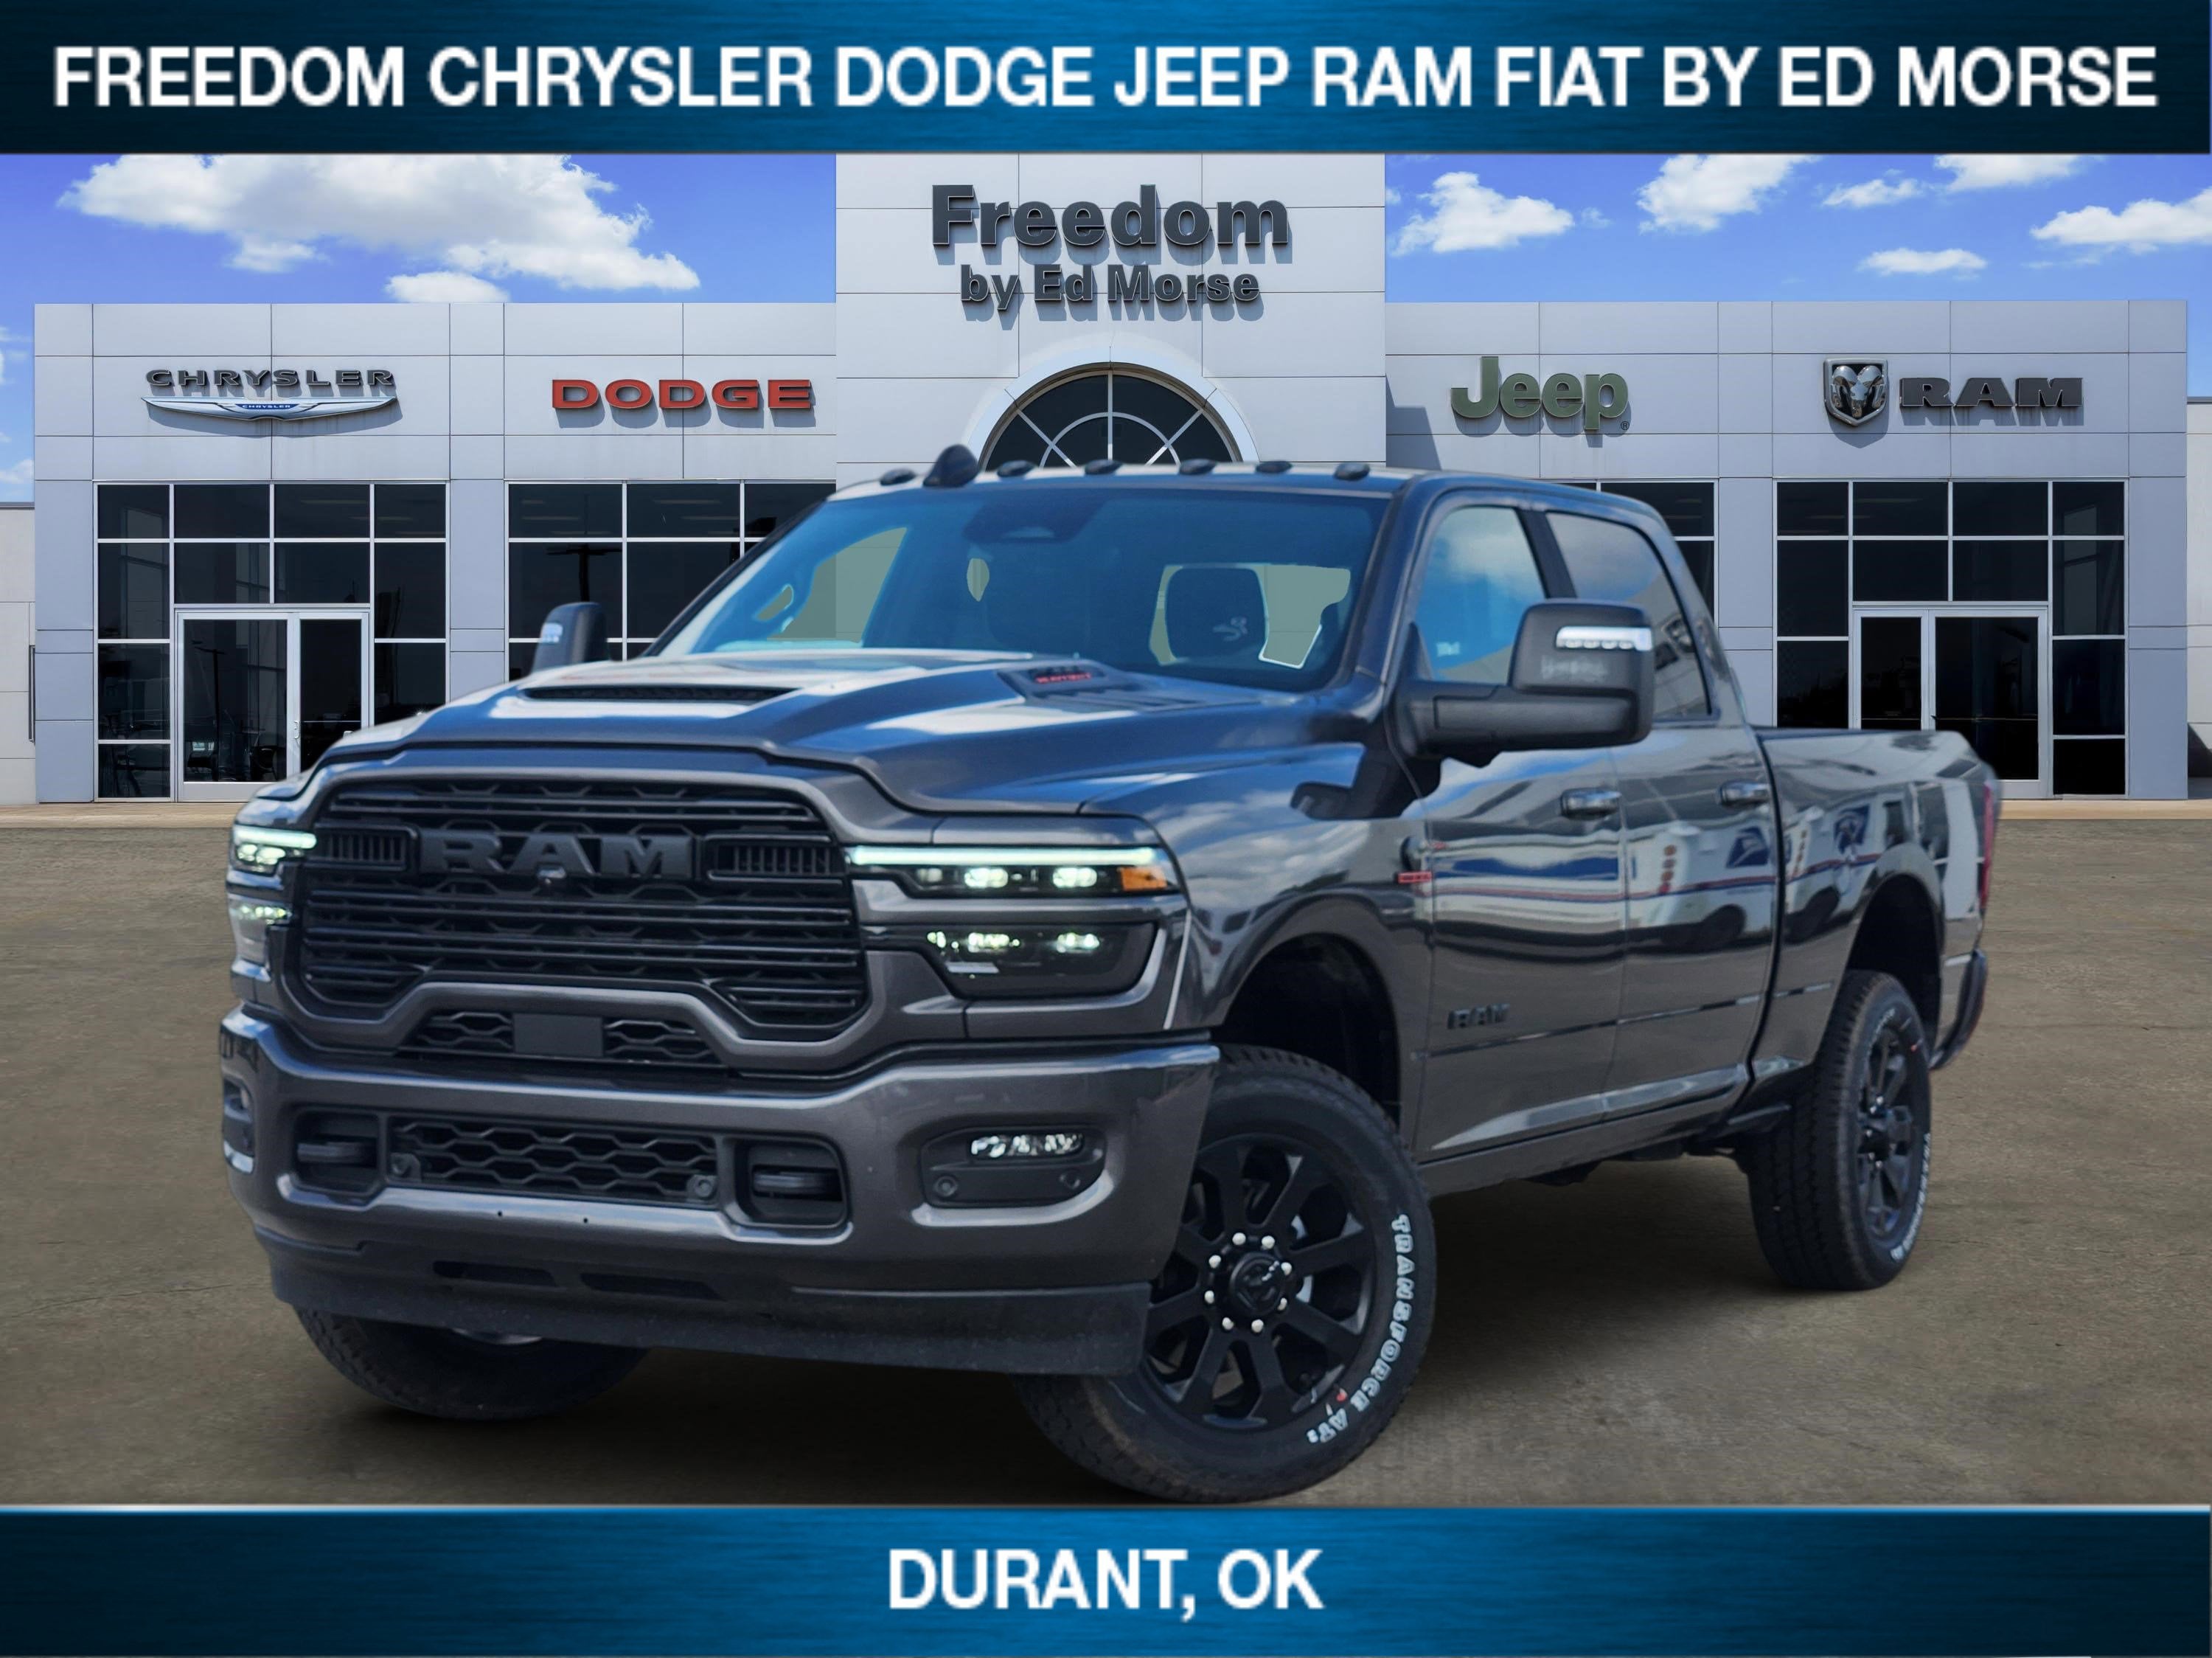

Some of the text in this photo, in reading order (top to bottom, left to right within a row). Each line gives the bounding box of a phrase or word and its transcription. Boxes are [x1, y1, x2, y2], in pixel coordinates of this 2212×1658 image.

[931, 184, 1290, 246] Freedom
[961, 264, 1261, 311] by Ed Morse
[145, 369, 397, 387] CHRYSLER
[552, 378, 812, 409] DODGE
[1450, 355, 1629, 431] Jeep
[1899, 377, 2084, 407] RAM
[418, 828, 693, 880] RAM
[1350, 1213, 1416, 1412] TRANSFORCE
